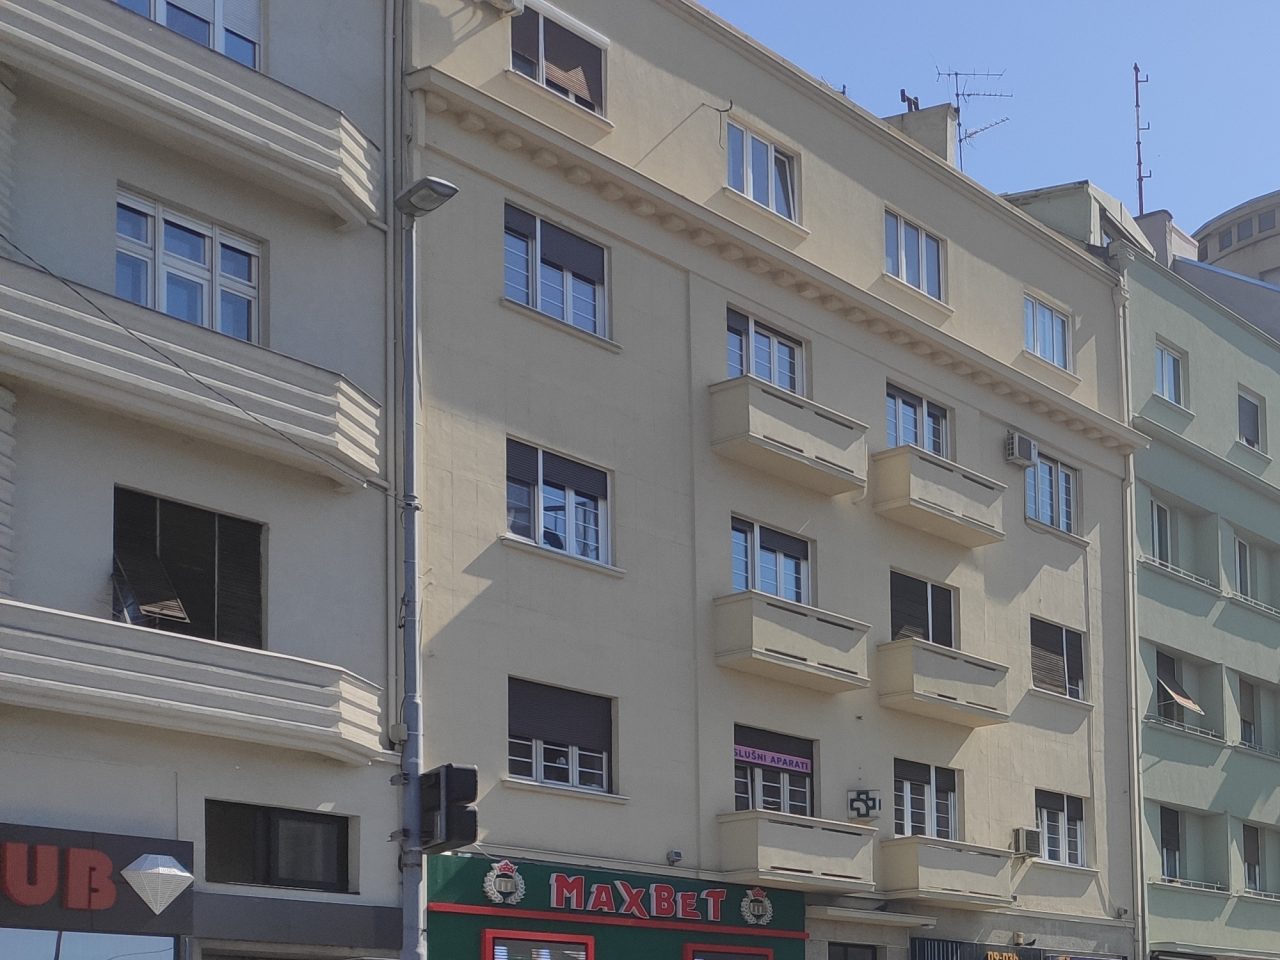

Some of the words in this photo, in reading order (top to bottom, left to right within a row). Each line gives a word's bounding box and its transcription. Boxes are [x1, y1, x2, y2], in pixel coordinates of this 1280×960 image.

[770, 756, 809, 771] APARATI
[1, 842, 118, 911] UB
[550, 872, 727, 922] MAXBET
